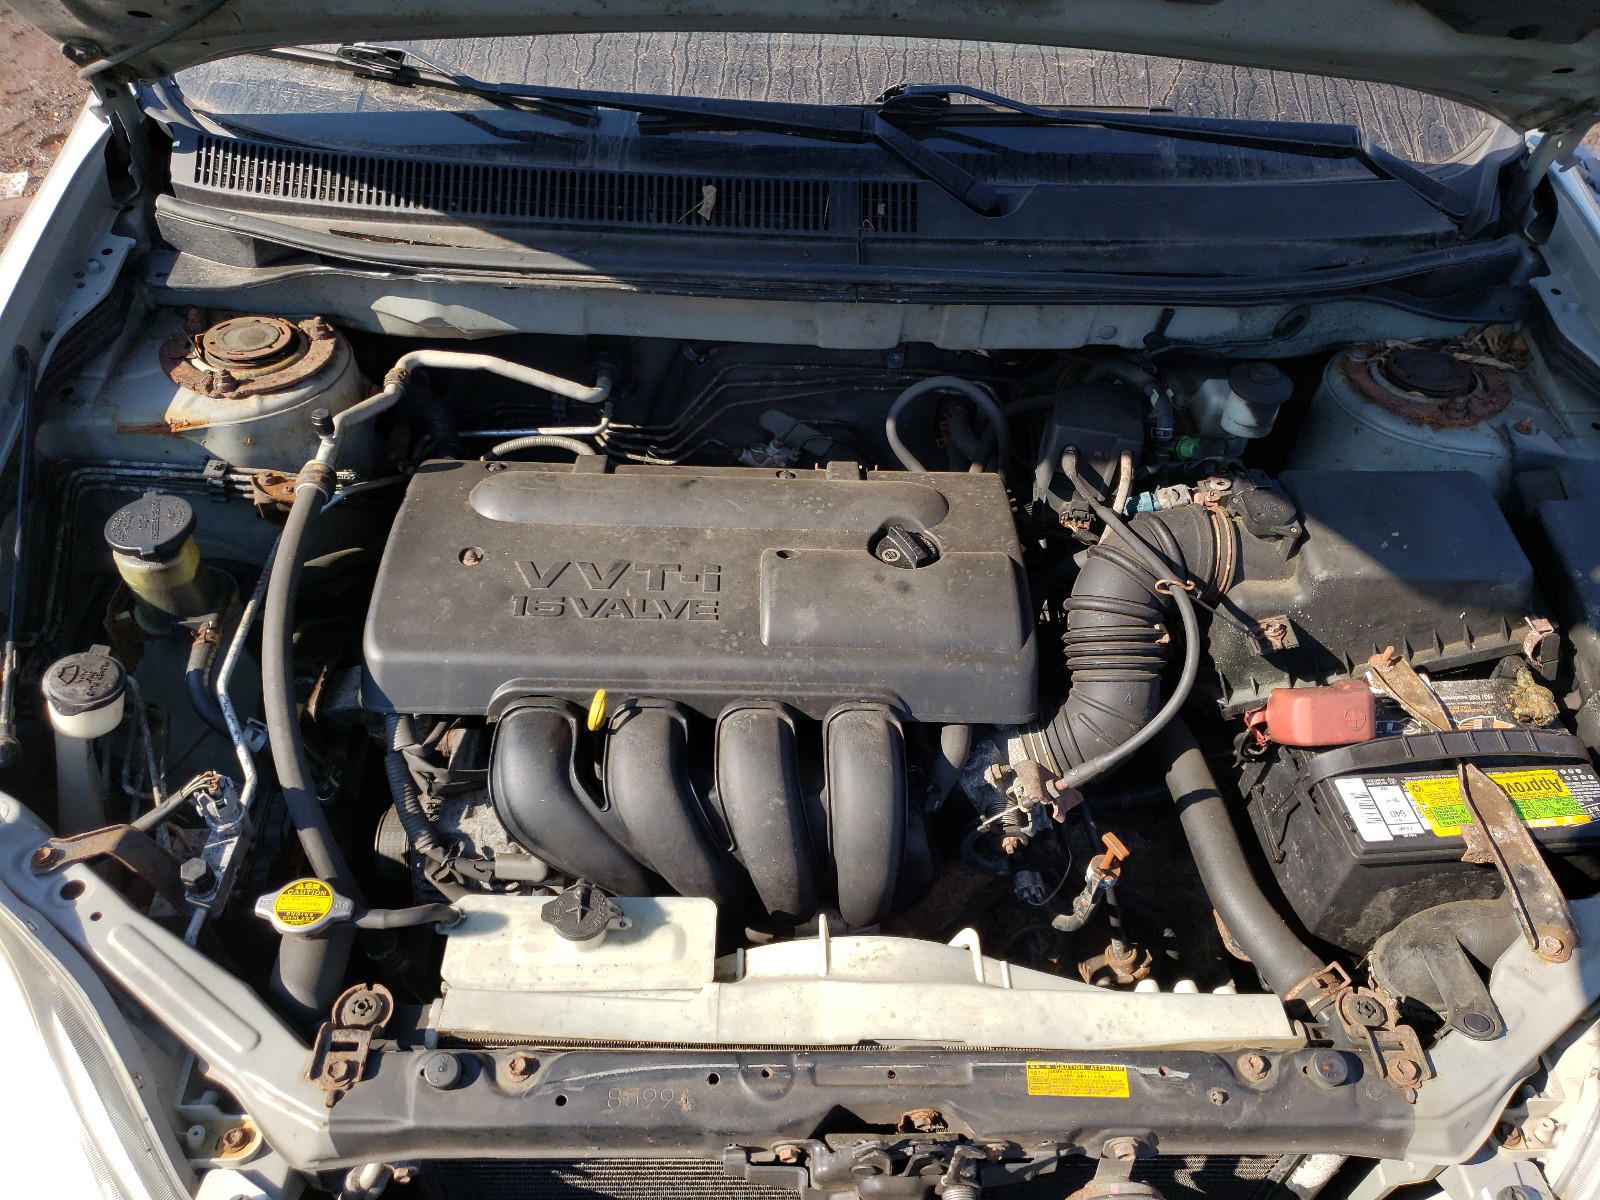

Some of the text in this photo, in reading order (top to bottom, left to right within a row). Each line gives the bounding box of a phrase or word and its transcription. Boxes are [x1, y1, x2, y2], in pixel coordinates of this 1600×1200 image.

[570, 598, 720, 621] VALVE
[1505, 777, 1563, 793] Approv
[287, 888, 327, 896] CAUTION
